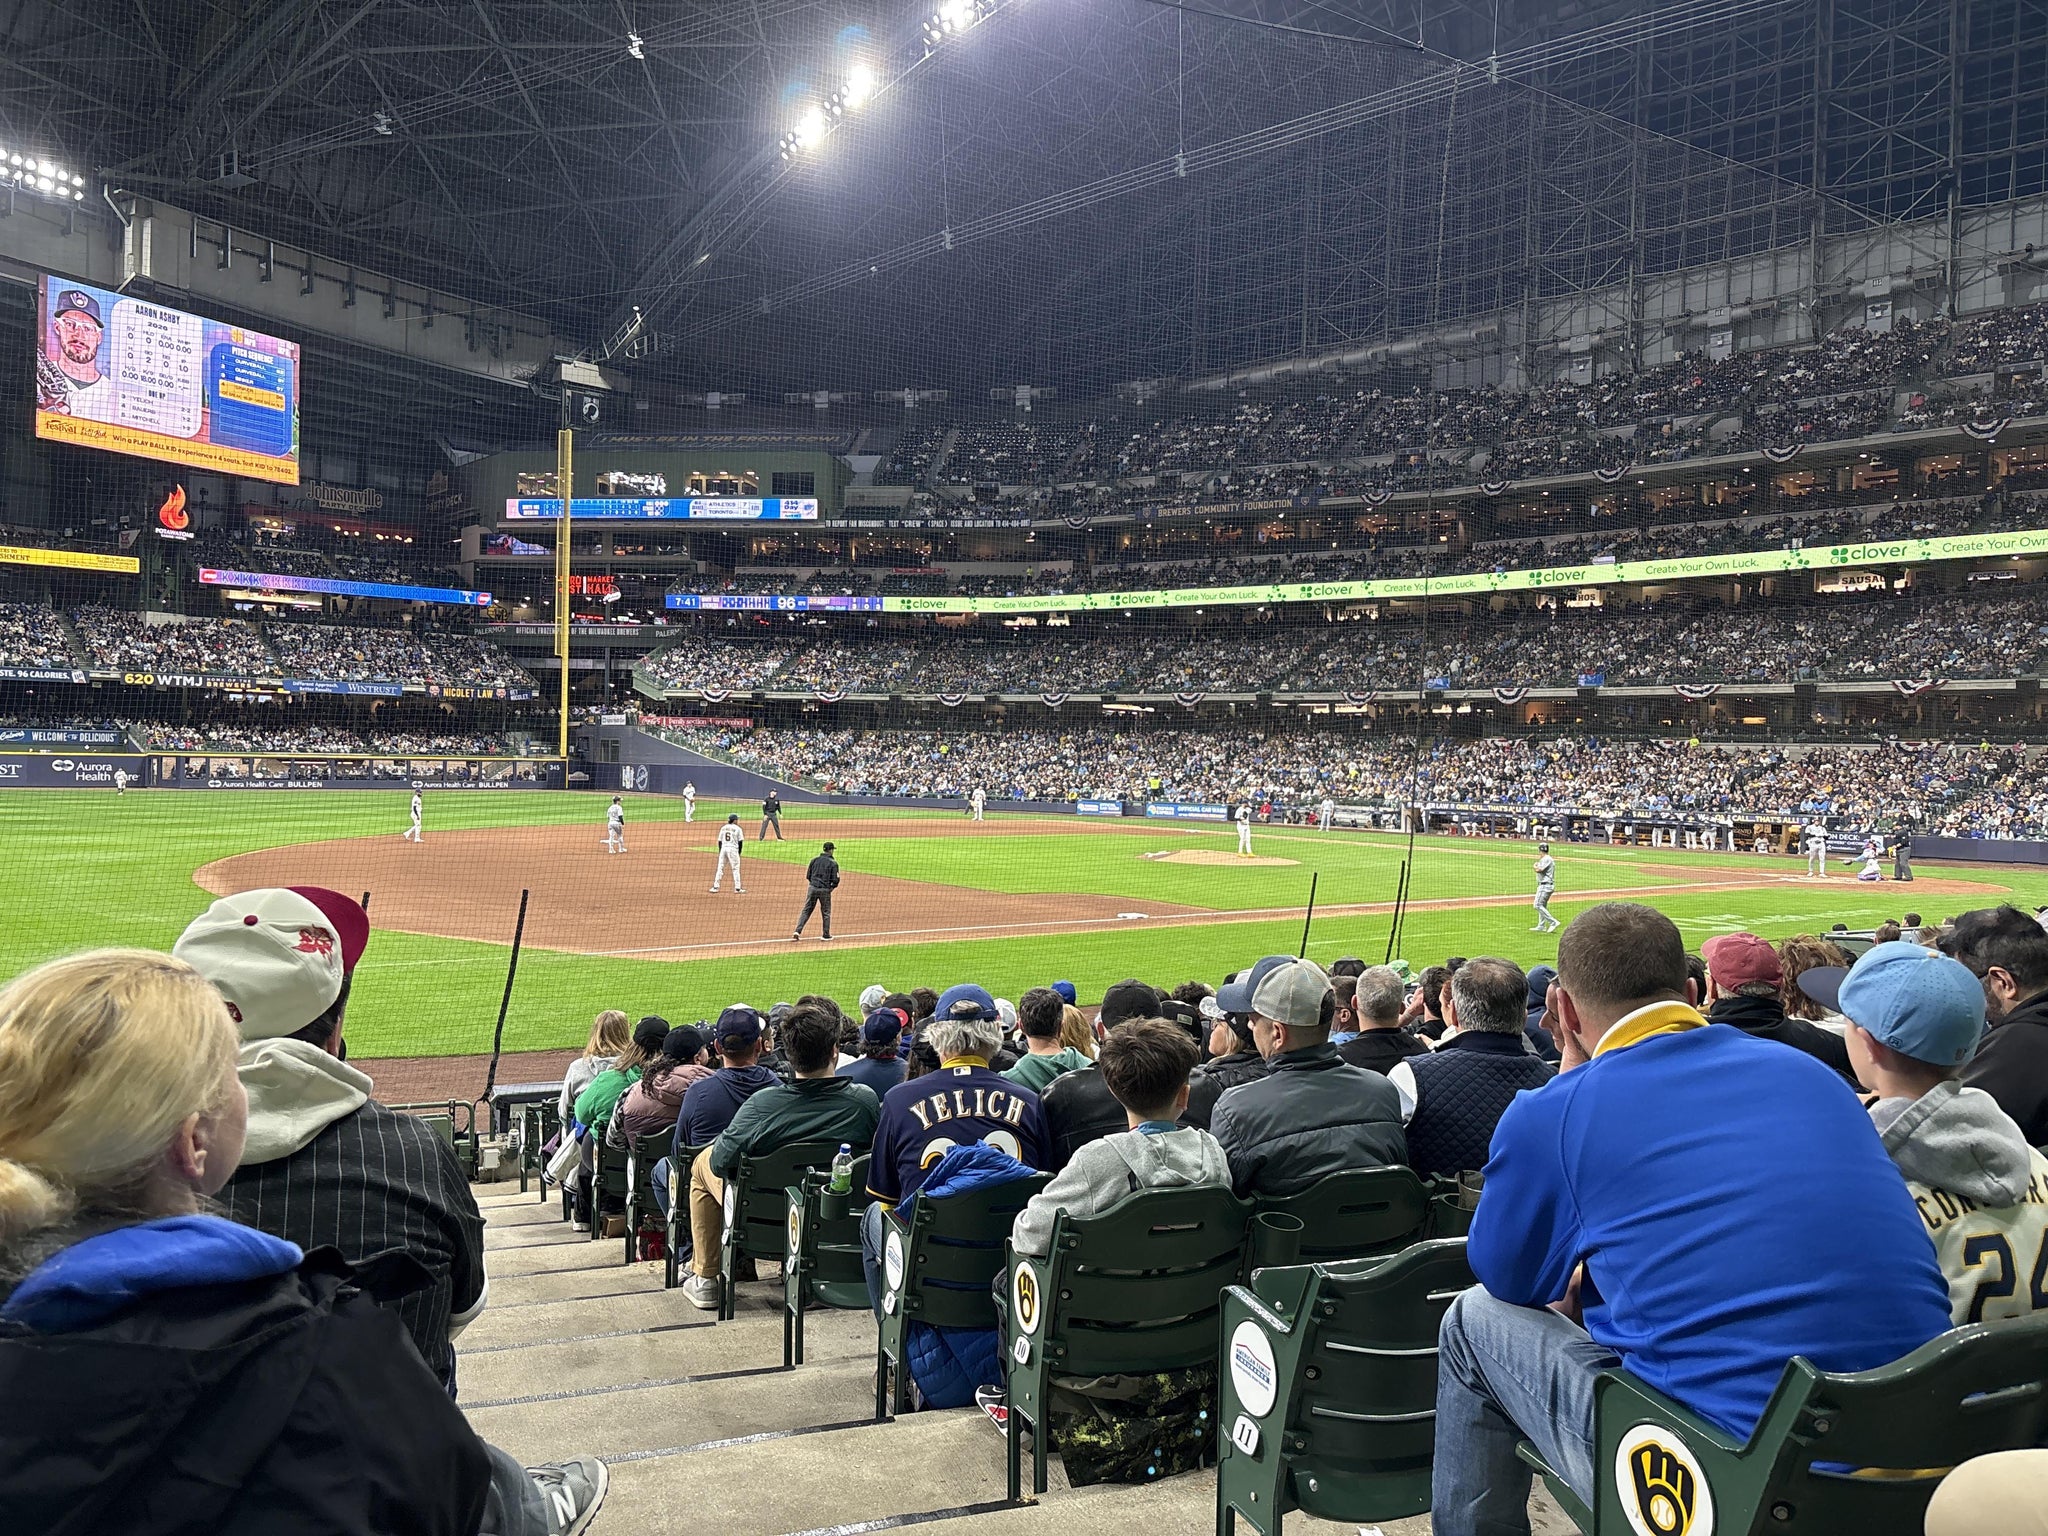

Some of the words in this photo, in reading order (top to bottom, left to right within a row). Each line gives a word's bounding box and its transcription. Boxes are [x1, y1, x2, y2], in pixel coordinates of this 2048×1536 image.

[135, 304, 158, 320] AARON
[159, 311, 180, 326] ASHBY
[158, 340, 175, 350] 0.00
[176, 344, 192, 354] 0.00
[146, 356, 152, 364] 2
[122, 370, 139, 380] 0.00
[158, 379, 174, 388] 0.00
[46, 419, 77, 434] festival
[113, 434, 126, 442] Win
[150, 442, 165, 450] BALL
[178, 448, 212, 460] experience
[306, 480, 382, 508] Johnsonville
[320, 500, 345, 508] PARTY
[1158, 506, 1191, 516] BREWERS
[1194, 503, 1240, 514] COMMUNITY
[1244, 499, 1293, 510] FOUNDATION
[832, 520, 848, 528] REPORT
[888, 520, 900, 528] TEXT
[974, 520, 994, 528] LOCATION
[1943, 542, 1984, 552] Create
[1987, 539, 2016, 550] Your
[1851, 545, 1908, 560] clover
[1646, 565, 1677, 574] Create
[1680, 563, 1702, 572] Your
[1705, 561, 1730, 570] Own
[1544, 570, 1586, 582] clover
[1314, 585, 1352, 596] clover
[1384, 584, 1412, 592] Create
[1414, 582, 1432, 591] Your
[1434, 582, 1454, 590] Own
[675, 598, 696, 606] 7:41
[912, 598, 947, 608] clover
[1122, 594, 1155, 604] clover
[1174, 594, 1198, 602] Create
[1219, 592, 1236, 600] Own
[777, 597, 796, 610] 96
[1018, 600, 1032, 608] Your
[1033, 600, 1048, 608] Own
[18, 670, 29, 678] 96
[30, 671, 70, 680] CALORIES.
[124, 674, 154, 685] 620
[157, 674, 202, 687] WTMJ
[348, 684, 397, 694] WINTRUST
[443, 688, 474, 698] NICOLET
[478, 689, 494, 698] LAW
[32, 732, 67, 742] WELCOME
[80, 732, 114, 742] DELICIOUS
[76, 762, 112, 772] Aurora
[76, 772, 111, 781] Health
[1488, 804, 1508, 812] THAT'S
[1579, 808, 1592, 816] ONE
[726, 832, 731, 842] 6
[909, 1088, 1026, 1130] YELICH
[1017, 1341, 1026, 1358] 10
[1236, 1348, 1256, 1366] AMERICAN
[1256, 1361, 1271, 1376] FAMILY
[1237, 1424, 1252, 1448] 11
[550, 1485, 578, 1528] N
